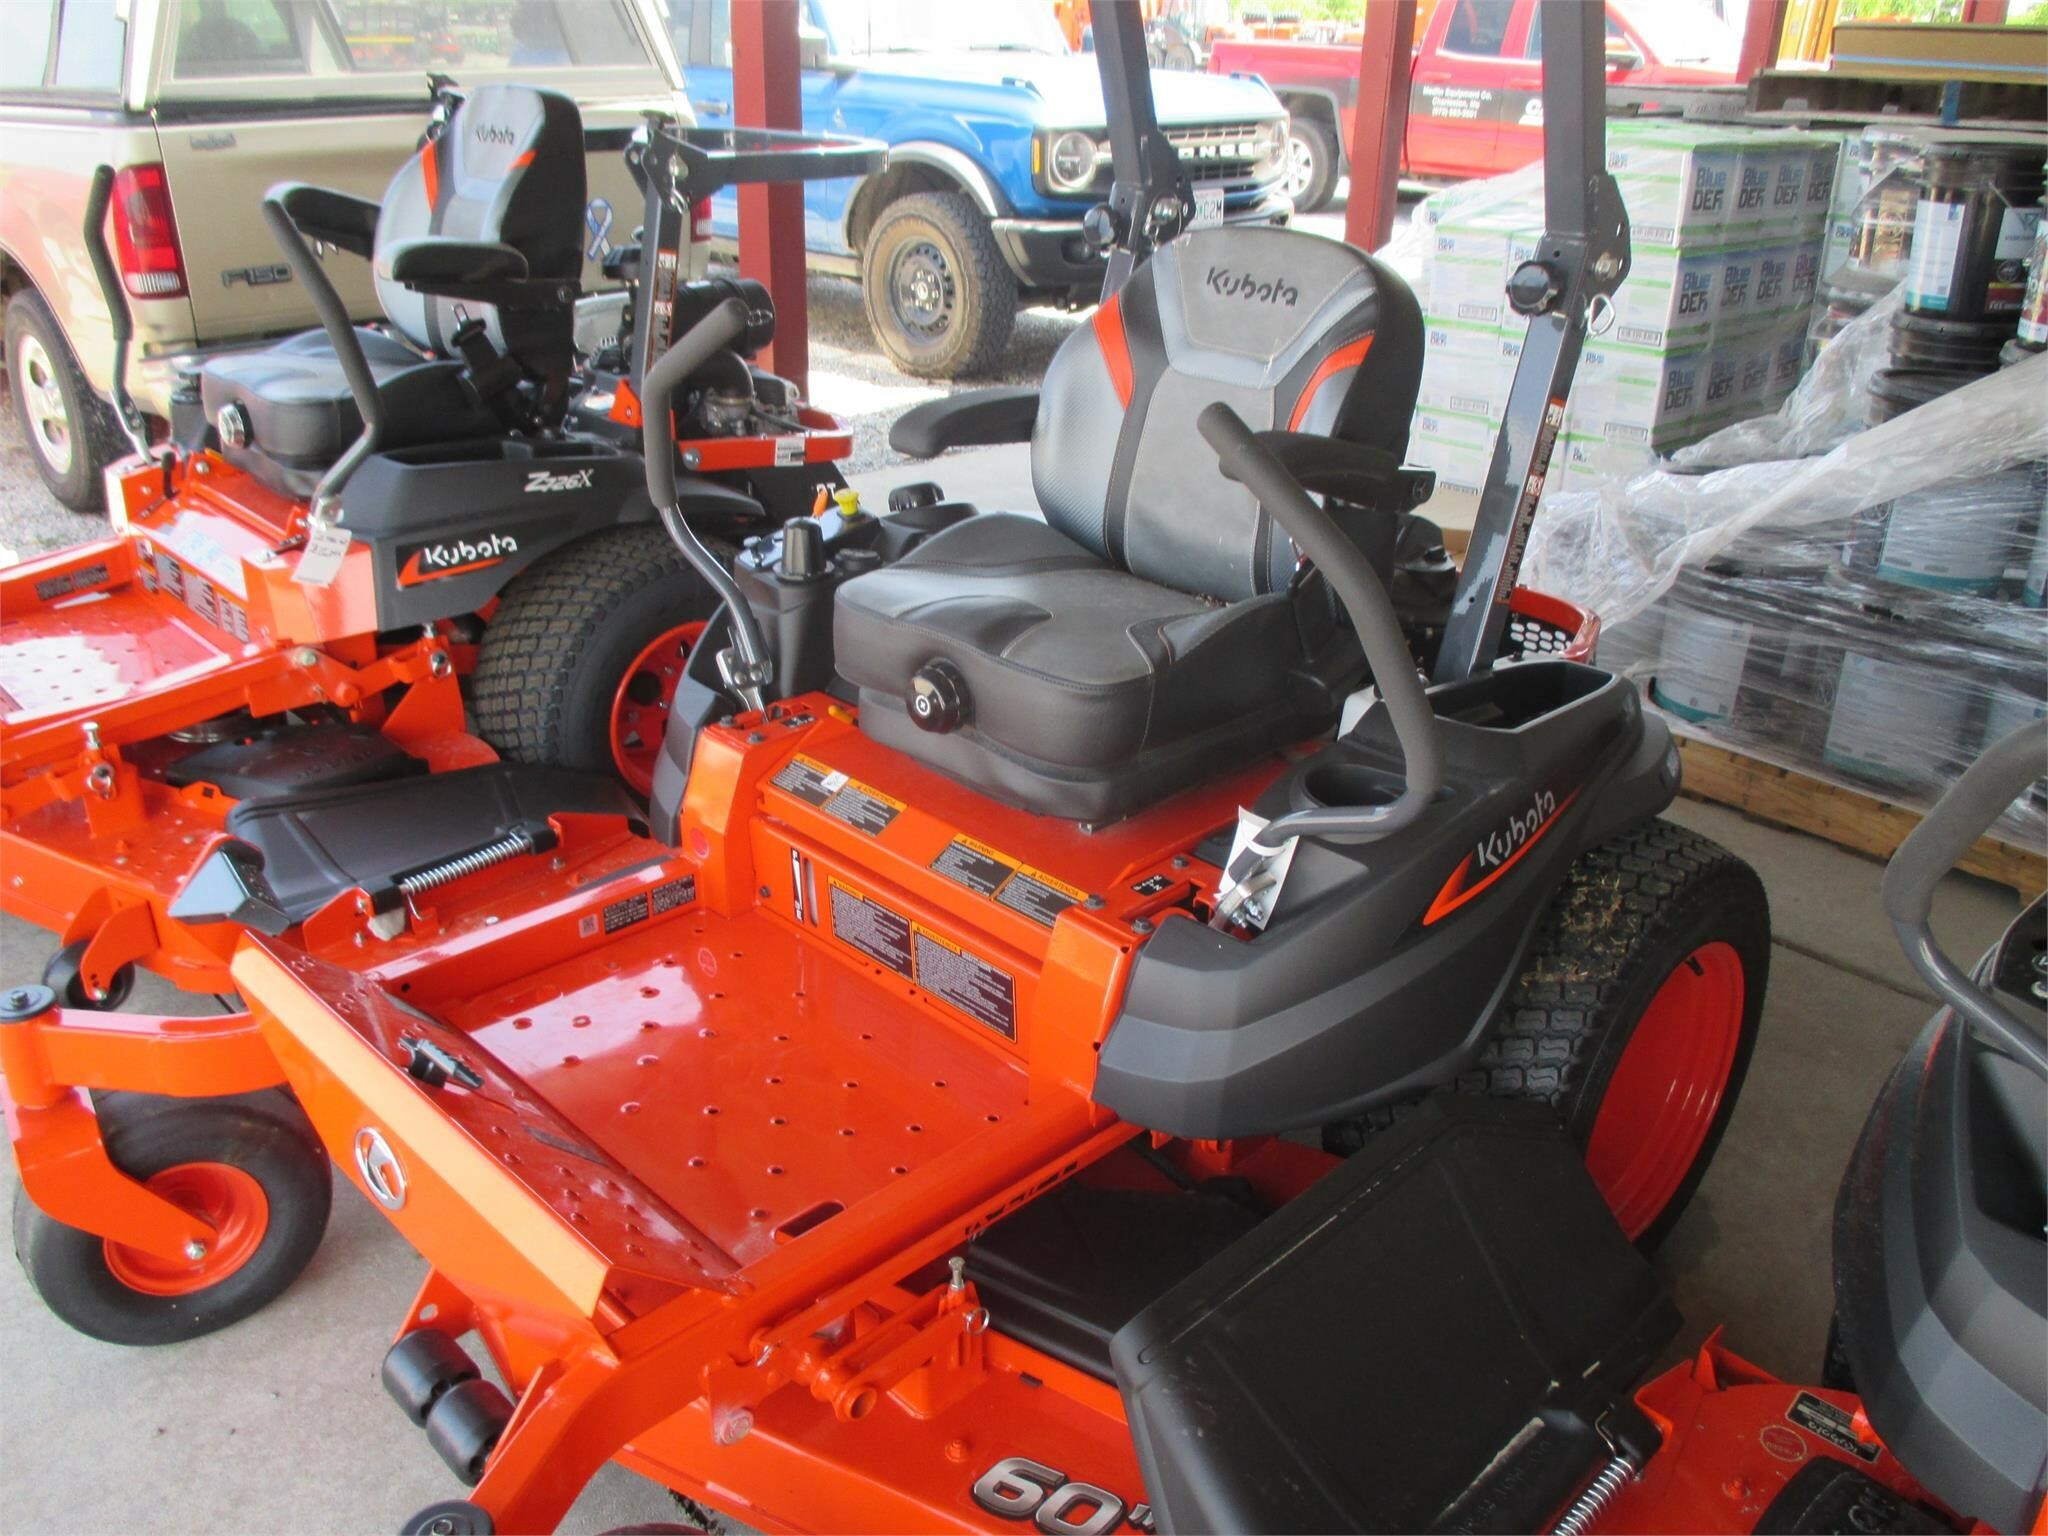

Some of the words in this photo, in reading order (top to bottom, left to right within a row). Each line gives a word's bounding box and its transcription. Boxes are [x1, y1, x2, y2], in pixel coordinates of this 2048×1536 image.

[1178, 142, 1254, 160] ONCO
[1696, 167, 1727, 187] Blue
[1743, 168, 1769, 186] Blue
[1778, 164, 1804, 183] Blue
[1692, 189, 1724, 211] DEF
[1738, 188, 1764, 208] DEF
[1773, 185, 1800, 205] DEF
[1724, 266, 1751, 284] Blue
[1760, 259, 1786, 277] Blue
[1206, 266, 1299, 307] Kubota
[1682, 272, 1712, 291] Blue
[1757, 278, 1782, 299] DEF
[1678, 291, 1708, 315] DEF
[1668, 369, 1696, 389] Blue
[1664, 388, 1693, 411] DEF
[1707, 378, 1733, 401] DEF
[524, 469, 595, 493] Z726X
[423, 533, 518, 567] Kubota
[1477, 790, 1556, 868] Kubota
[1806, 1420, 1860, 1455] Kubota
